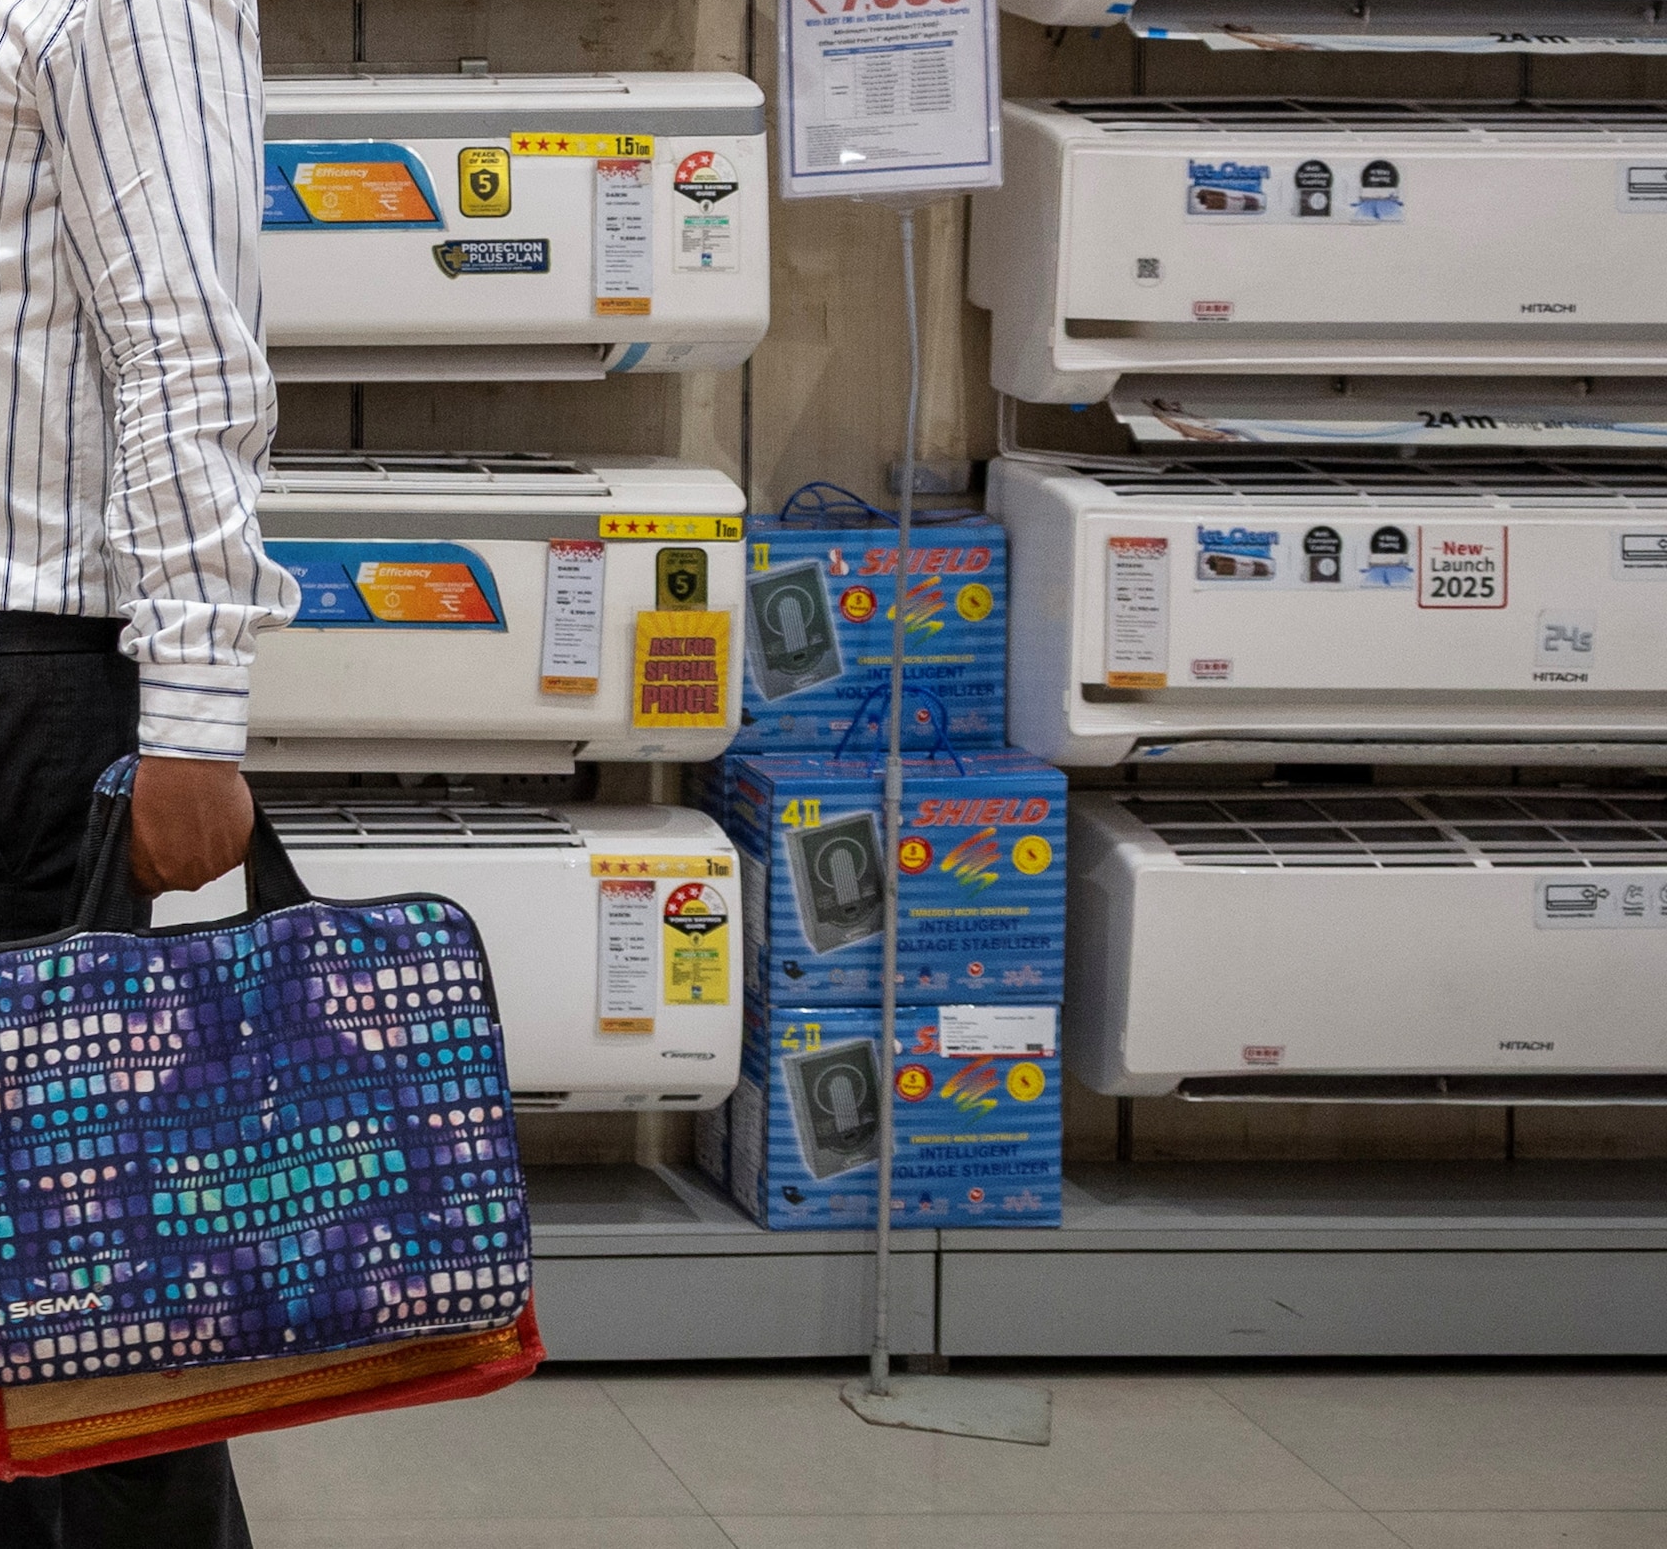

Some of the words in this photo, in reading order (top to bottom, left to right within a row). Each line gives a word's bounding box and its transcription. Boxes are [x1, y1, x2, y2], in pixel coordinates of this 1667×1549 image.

[1521, 304, 1576, 312] HITACHI
[1418, 412, 1456, 428] 24
[379, 568, 432, 579] Efficiency
[1431, 577, 1495, 598] 2025
[649, 637, 678, 657] ASK
[682, 637, 715, 656] FOR
[645, 661, 717, 682] SPECIAL
[1533, 673, 1588, 682] HITACHI
[642, 685, 718, 714] PRICE
[913, 799, 1049, 826] SHIELD
